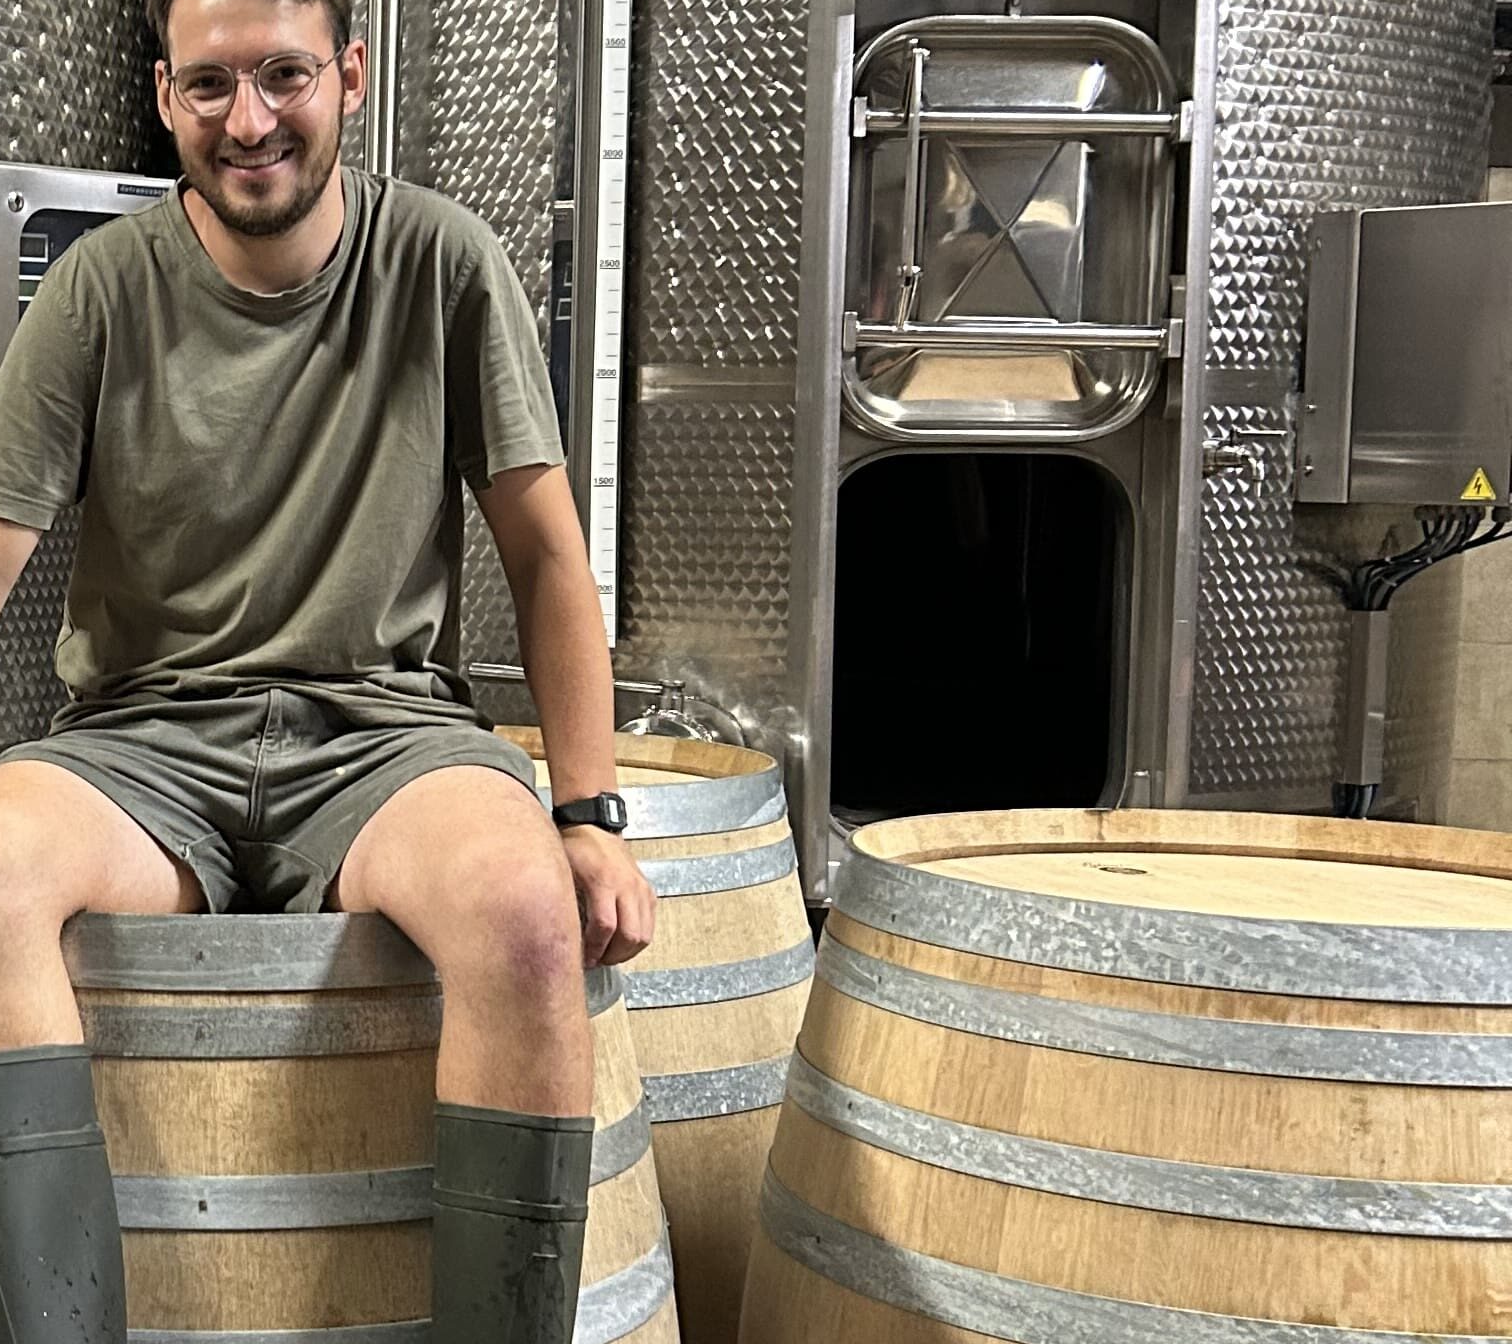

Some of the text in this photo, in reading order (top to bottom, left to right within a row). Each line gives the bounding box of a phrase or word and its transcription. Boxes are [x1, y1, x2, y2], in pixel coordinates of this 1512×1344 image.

[605, 38, 626, 46] 3500
[602, 149, 624, 158] 3000
[599, 260, 621, 268] 2500
[596, 369, 617, 377] 2000
[593, 477, 614, 486] 1500
